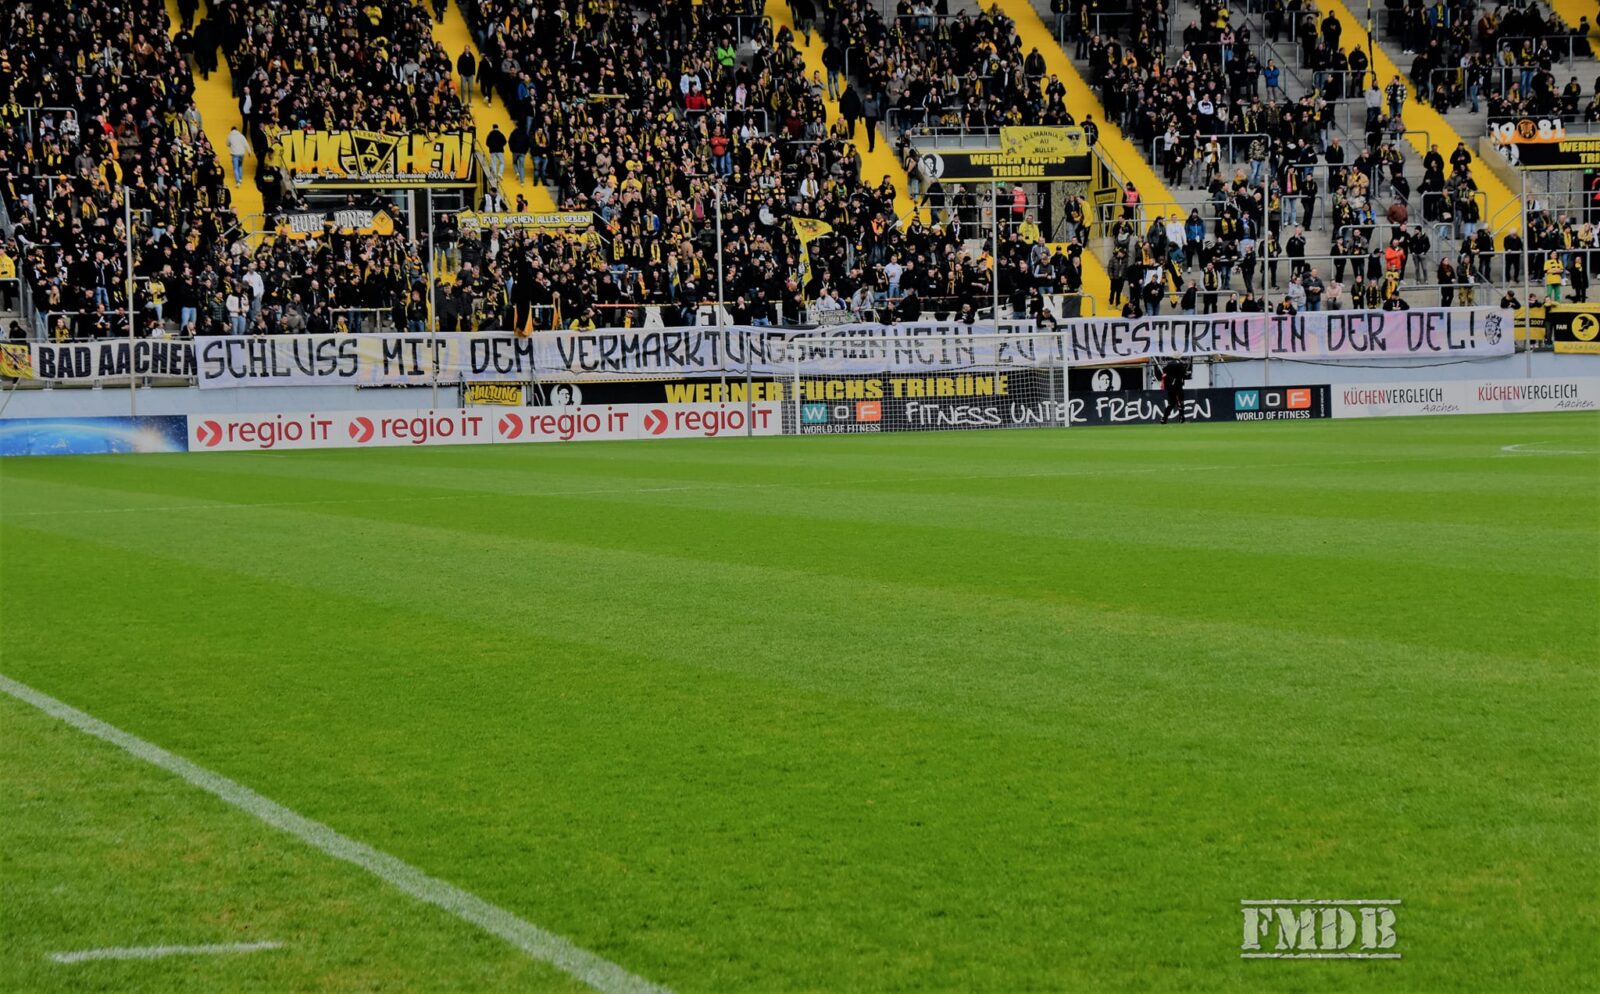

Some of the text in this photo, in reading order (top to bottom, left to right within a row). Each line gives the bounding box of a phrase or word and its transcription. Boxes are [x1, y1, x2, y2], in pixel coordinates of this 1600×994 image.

[1538, 118, 1563, 139] 81
[991, 163, 1045, 177] TRIBÜNE
[537, 215, 560, 224] ALLES
[202, 337, 358, 380] SCHLUSS
[382, 337, 447, 376] MIT
[470, 337, 534, 374] DEM
[1270, 315, 1305, 354] IN
[1327, 312, 1387, 352] DER
[1407, 310, 1476, 351] DEL!
[39, 341, 198, 379] BAD AACHEN
[470, 384, 517, 402] HALTUNG
[665, 375, 1009, 403] WERNER FUCHS TRIBÜNE
[1343, 387, 1443, 406] KÜCHENVERGLEICH
[1478, 383, 1578, 400] KÜCHENVERGLEICH
[905, 402, 1002, 426] FITNESS
[1011, 399, 1087, 426] UNTER
[1422, 403, 1460, 413] Aachen
[1554, 399, 1595, 409] Aachen
[529, 406, 601, 441] regio
[675, 403, 745, 436] regio
[1236, 410, 1311, 421] WORLD OF FITNESS
[228, 414, 302, 449] regio
[381, 410, 454, 444] regio
[803, 423, 881, 434] WORLD OF FITNESS
